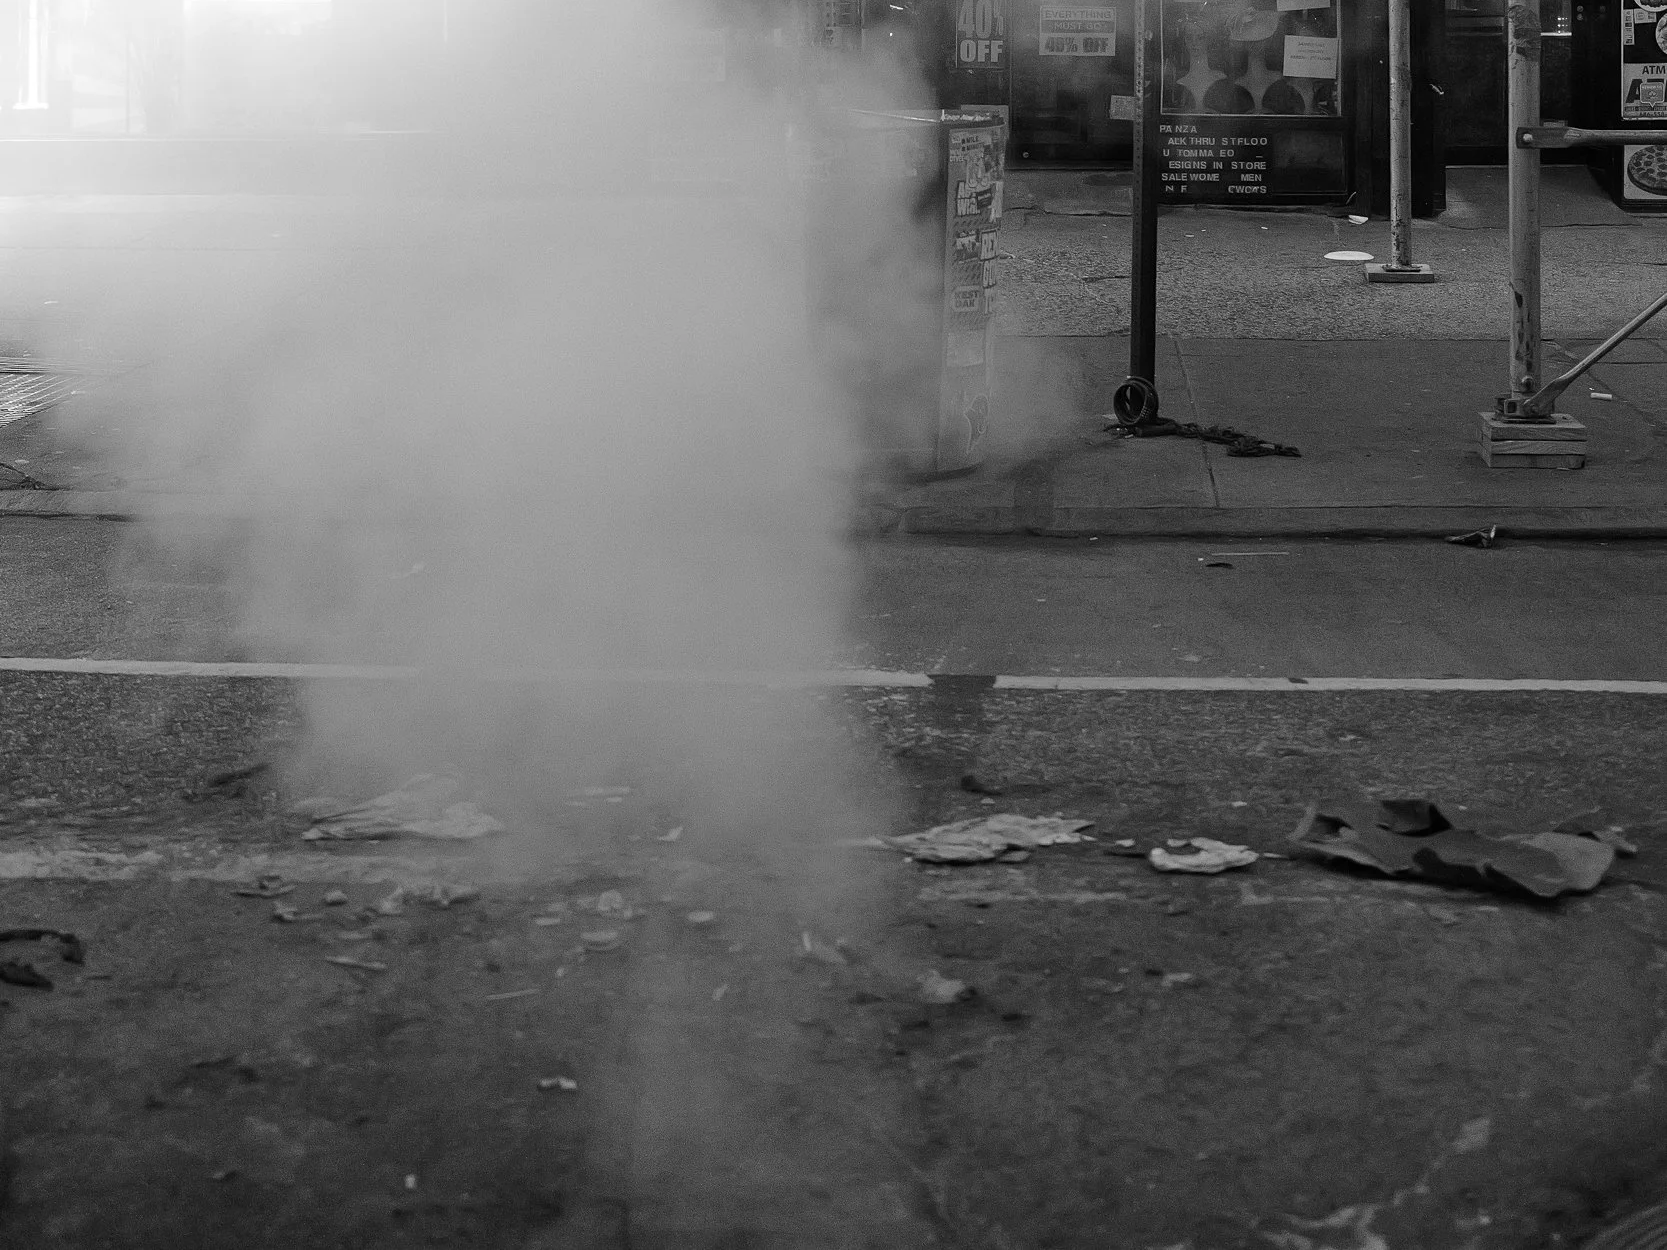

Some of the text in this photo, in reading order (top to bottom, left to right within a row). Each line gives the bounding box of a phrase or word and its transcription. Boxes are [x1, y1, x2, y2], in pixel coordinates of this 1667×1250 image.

[1045, 9, 1112, 19] EVERYTHING
[959, 40, 1004, 63] OFF
[1642, 65, 1666, 75] ATM
[1188, 137, 1216, 146] THRU
[1168, 160, 1267, 170] ESIGNS IN STORE
[1161, 172, 1188, 182] SALE
[1240, 173, 1263, 182] MEN
